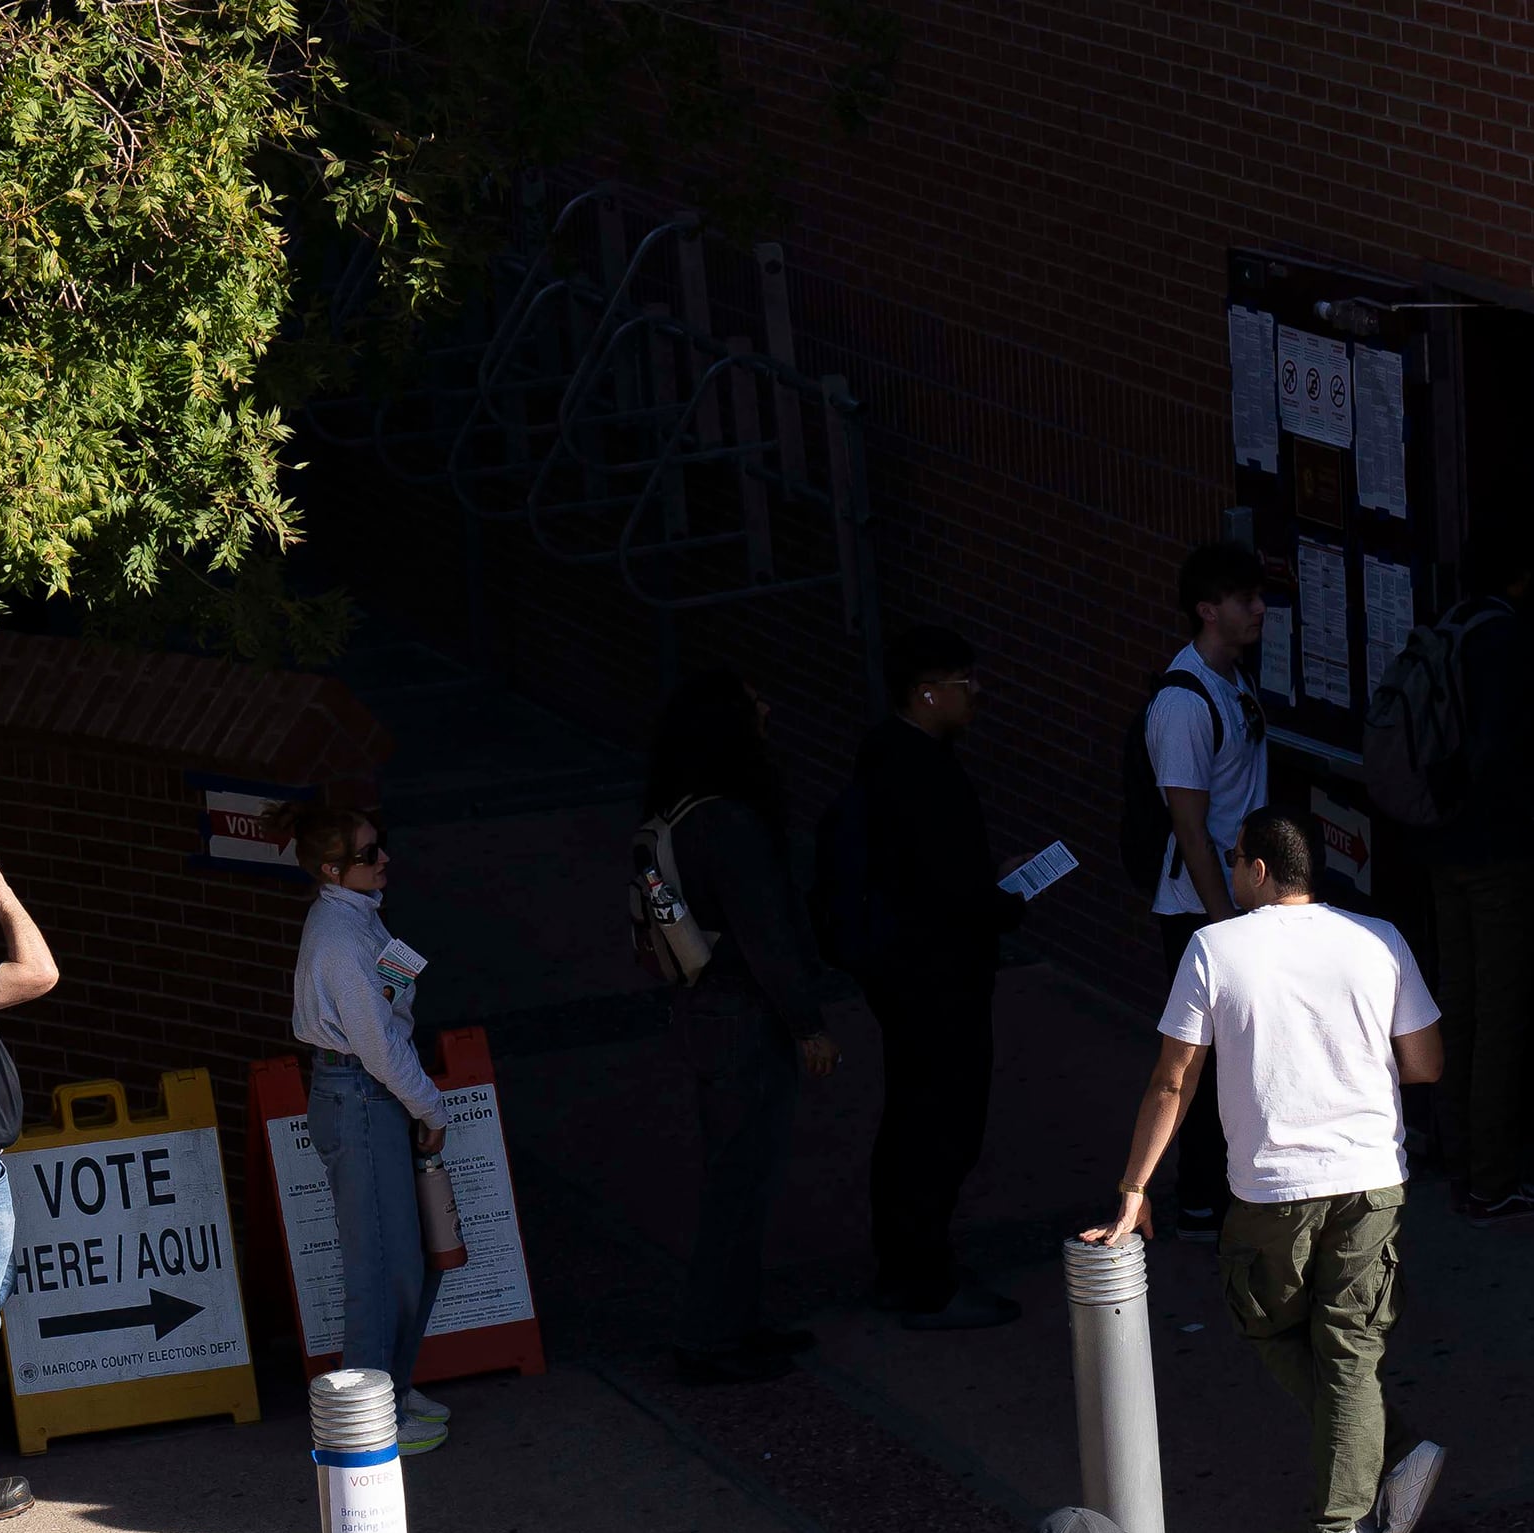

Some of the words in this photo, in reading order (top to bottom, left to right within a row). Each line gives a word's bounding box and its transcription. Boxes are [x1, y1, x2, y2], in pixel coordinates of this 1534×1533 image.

[1323, 821, 1352, 856] VOTE
[442, 1095, 468, 1107] ista
[471, 1091, 488, 1103] Su
[290, 1120, 309, 1132] Ha
[295, 1137, 311, 1149] ID
[33, 1148, 176, 1219] VOTE
[13, 1238, 108, 1295] HERE
[137, 1223, 222, 1281] AQUI
[42, 1359, 98, 1377] MARICOPA
[101, 1352, 144, 1369] COUNTY
[148, 1344, 207, 1363] ELECTIONS
[210, 1340, 240, 1355] DEPT.
[350, 1472, 395, 1487] VOTERS
[341, 1507, 367, 1519] Bring
[369, 1507, 378, 1516] in
[342, 1522, 379, 1533] parking
